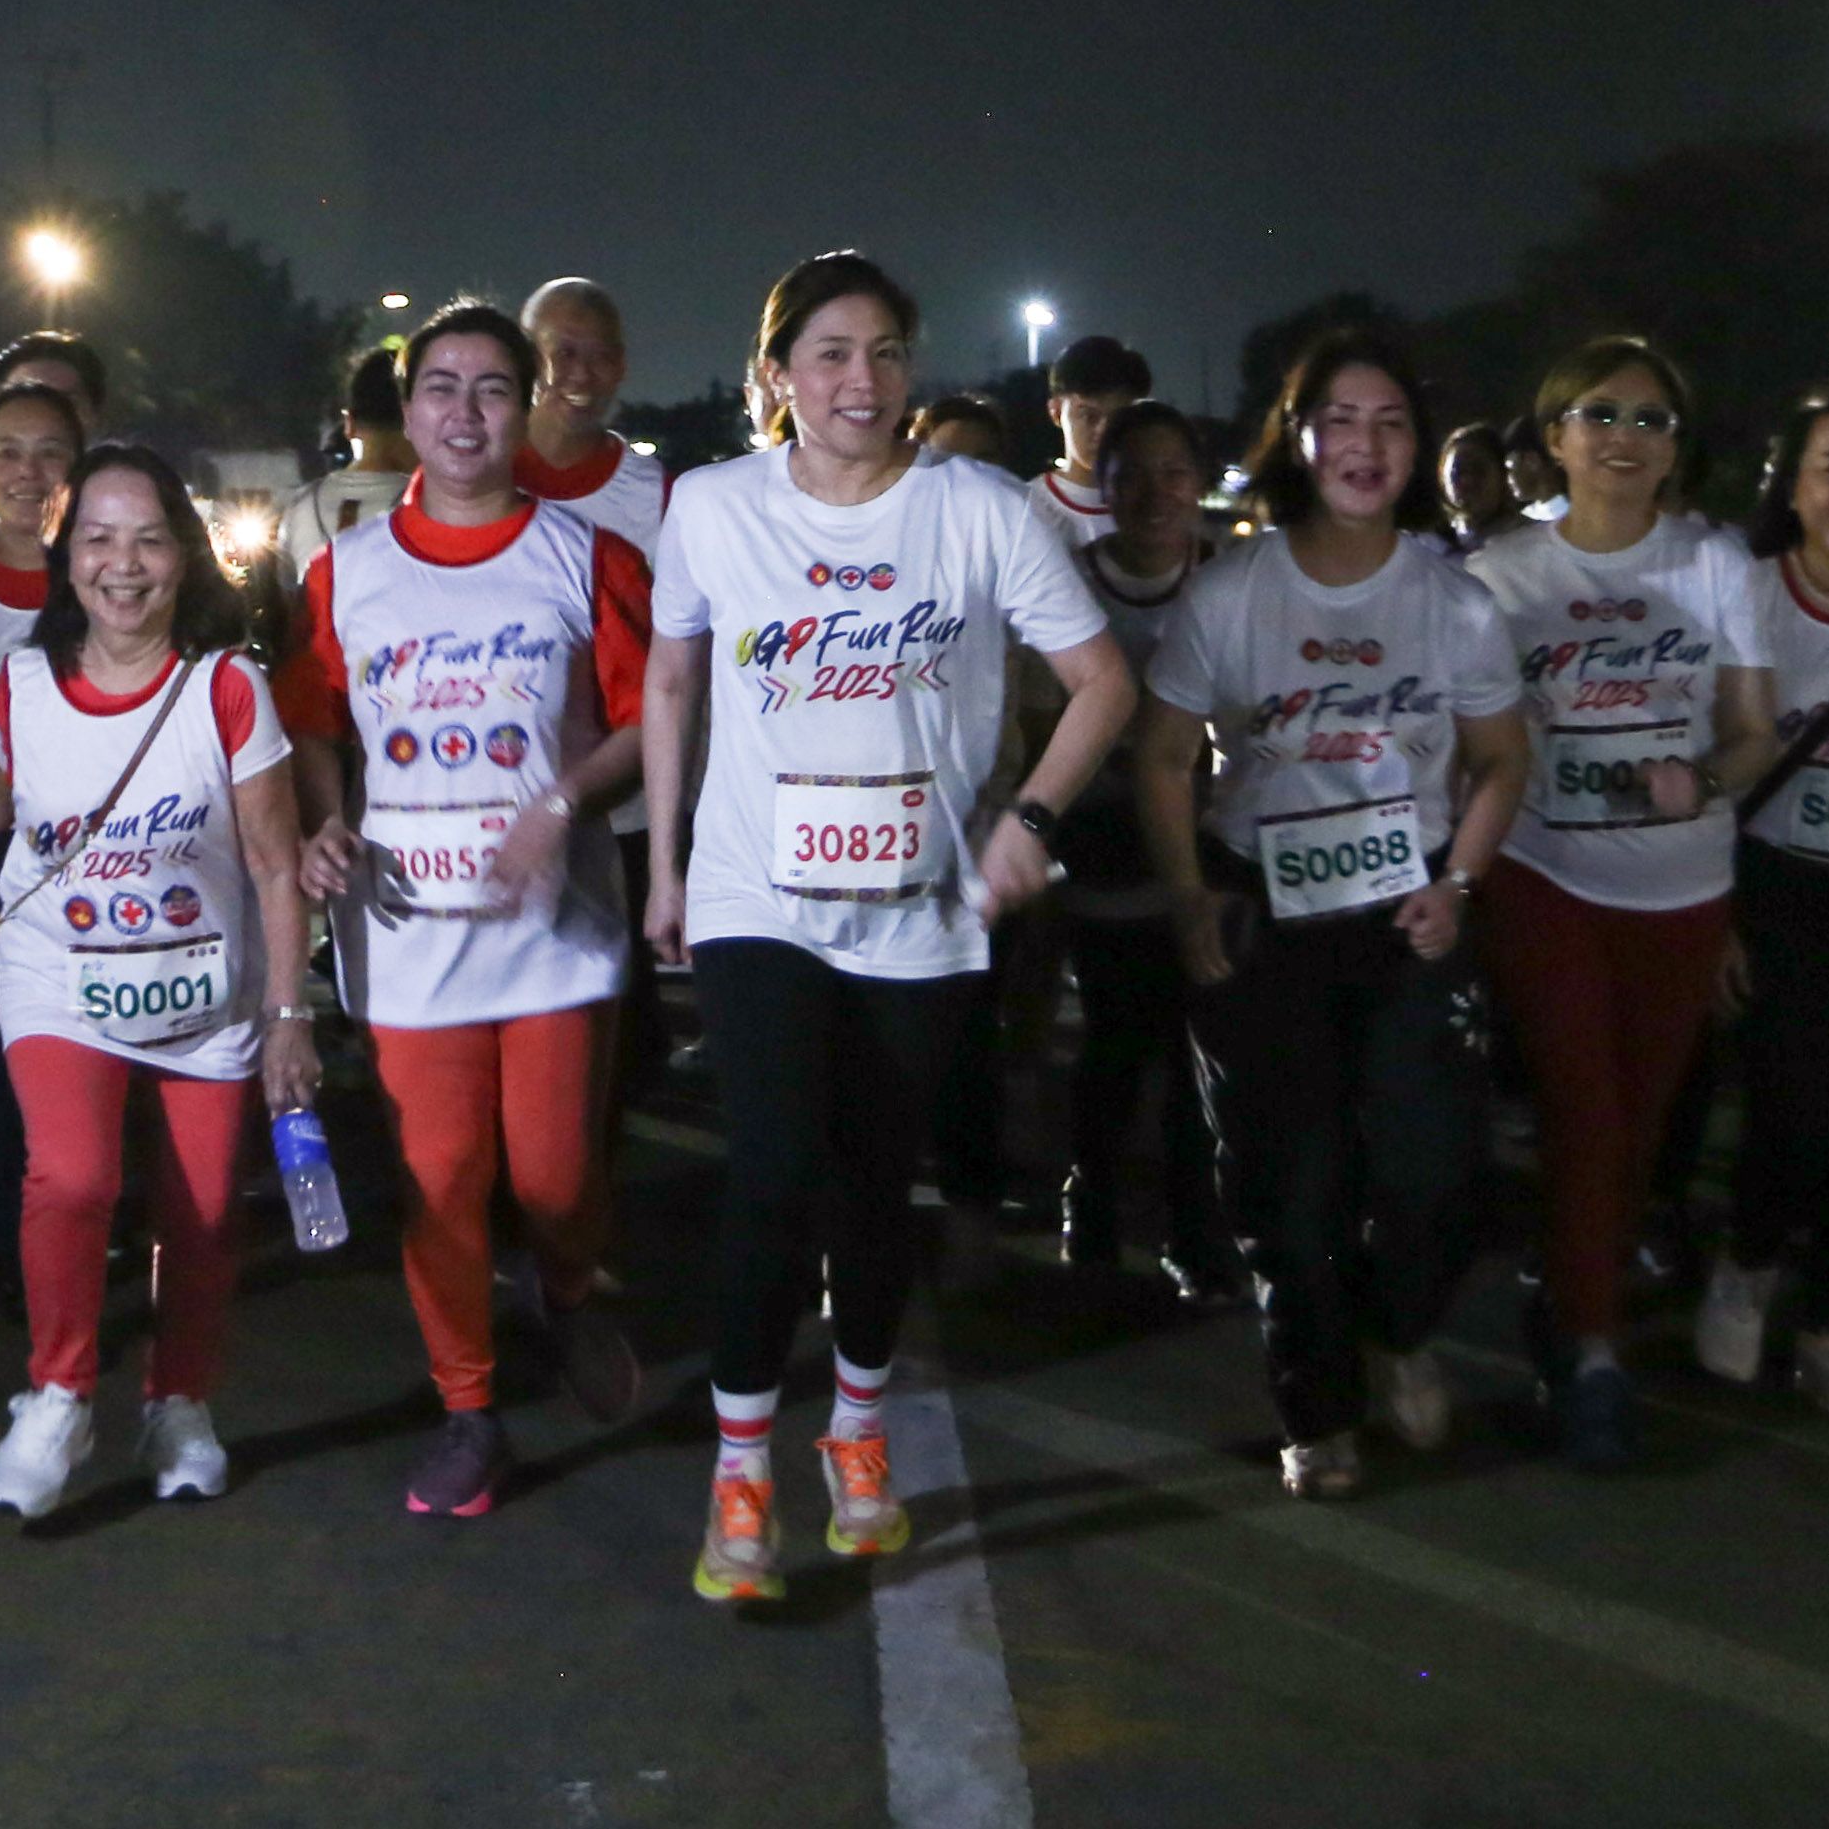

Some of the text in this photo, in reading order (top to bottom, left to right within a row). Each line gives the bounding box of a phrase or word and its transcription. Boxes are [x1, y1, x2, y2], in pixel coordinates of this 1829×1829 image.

[735, 599, 965, 672] OGP Fun Run
[806, 661, 907, 702] 2025
[1572, 677, 1659, 711] 2025
[1556, 754, 1684, 795] S00
[146, 794, 209, 845] Run
[795, 821, 920, 863] 30823
[1276, 830, 1411, 887] S0088
[83, 848, 158, 880] 2025
[84, 972, 213, 1020] S0001
